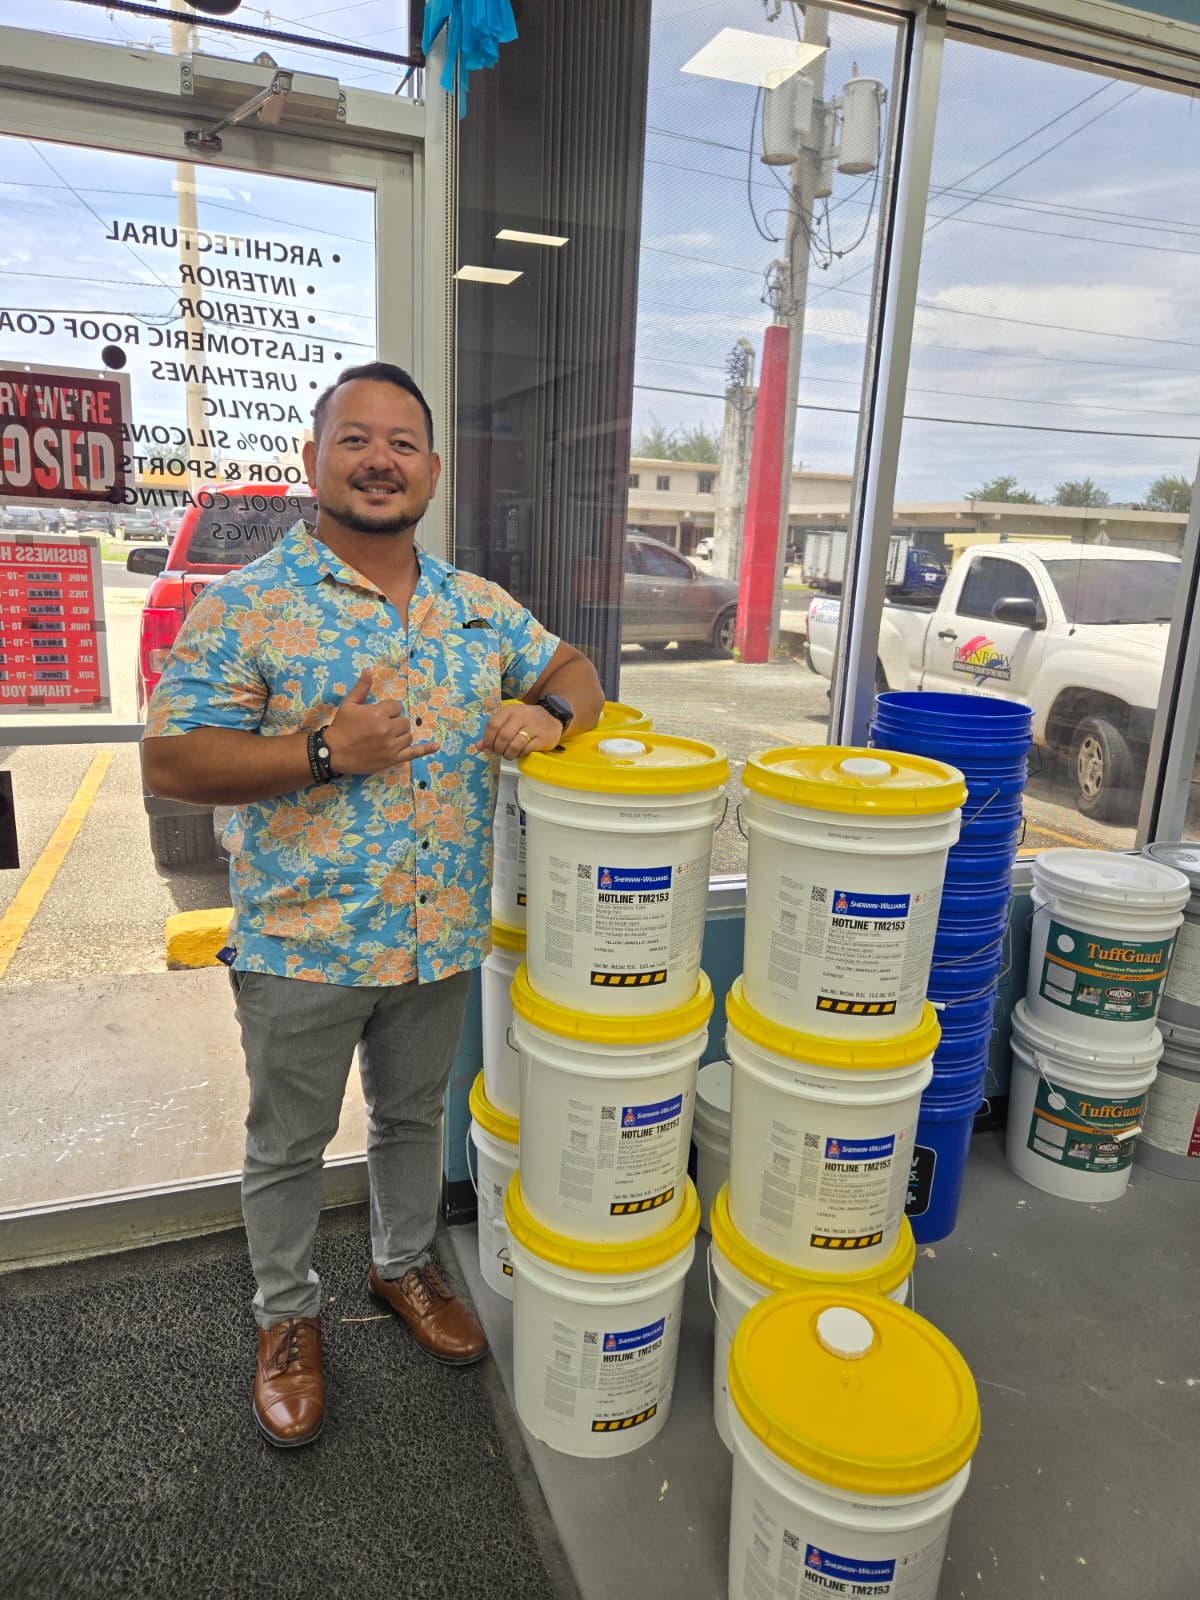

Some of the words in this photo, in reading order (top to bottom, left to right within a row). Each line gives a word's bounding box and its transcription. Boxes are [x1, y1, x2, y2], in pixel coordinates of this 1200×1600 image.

[34, 384, 112, 425] WE'RE
[0, 424, 115, 492] OSED
[598, 893, 634, 904] HOTLINE
[638, 892, 669, 903] TM2153
[832, 917, 871, 930] HOTLINE
[874, 921, 906, 930] TM2153
[1088, 942, 1163, 964] TuffGuard
[621, 1128, 653, 1139] HOTLINE
[825, 1162, 860, 1172] HOTLINE
[603, 1352, 635, 1363] HOTLINE
[805, 1570, 848, 1592] HOTLINE
[851, 1584, 890, 1595] TM2153
